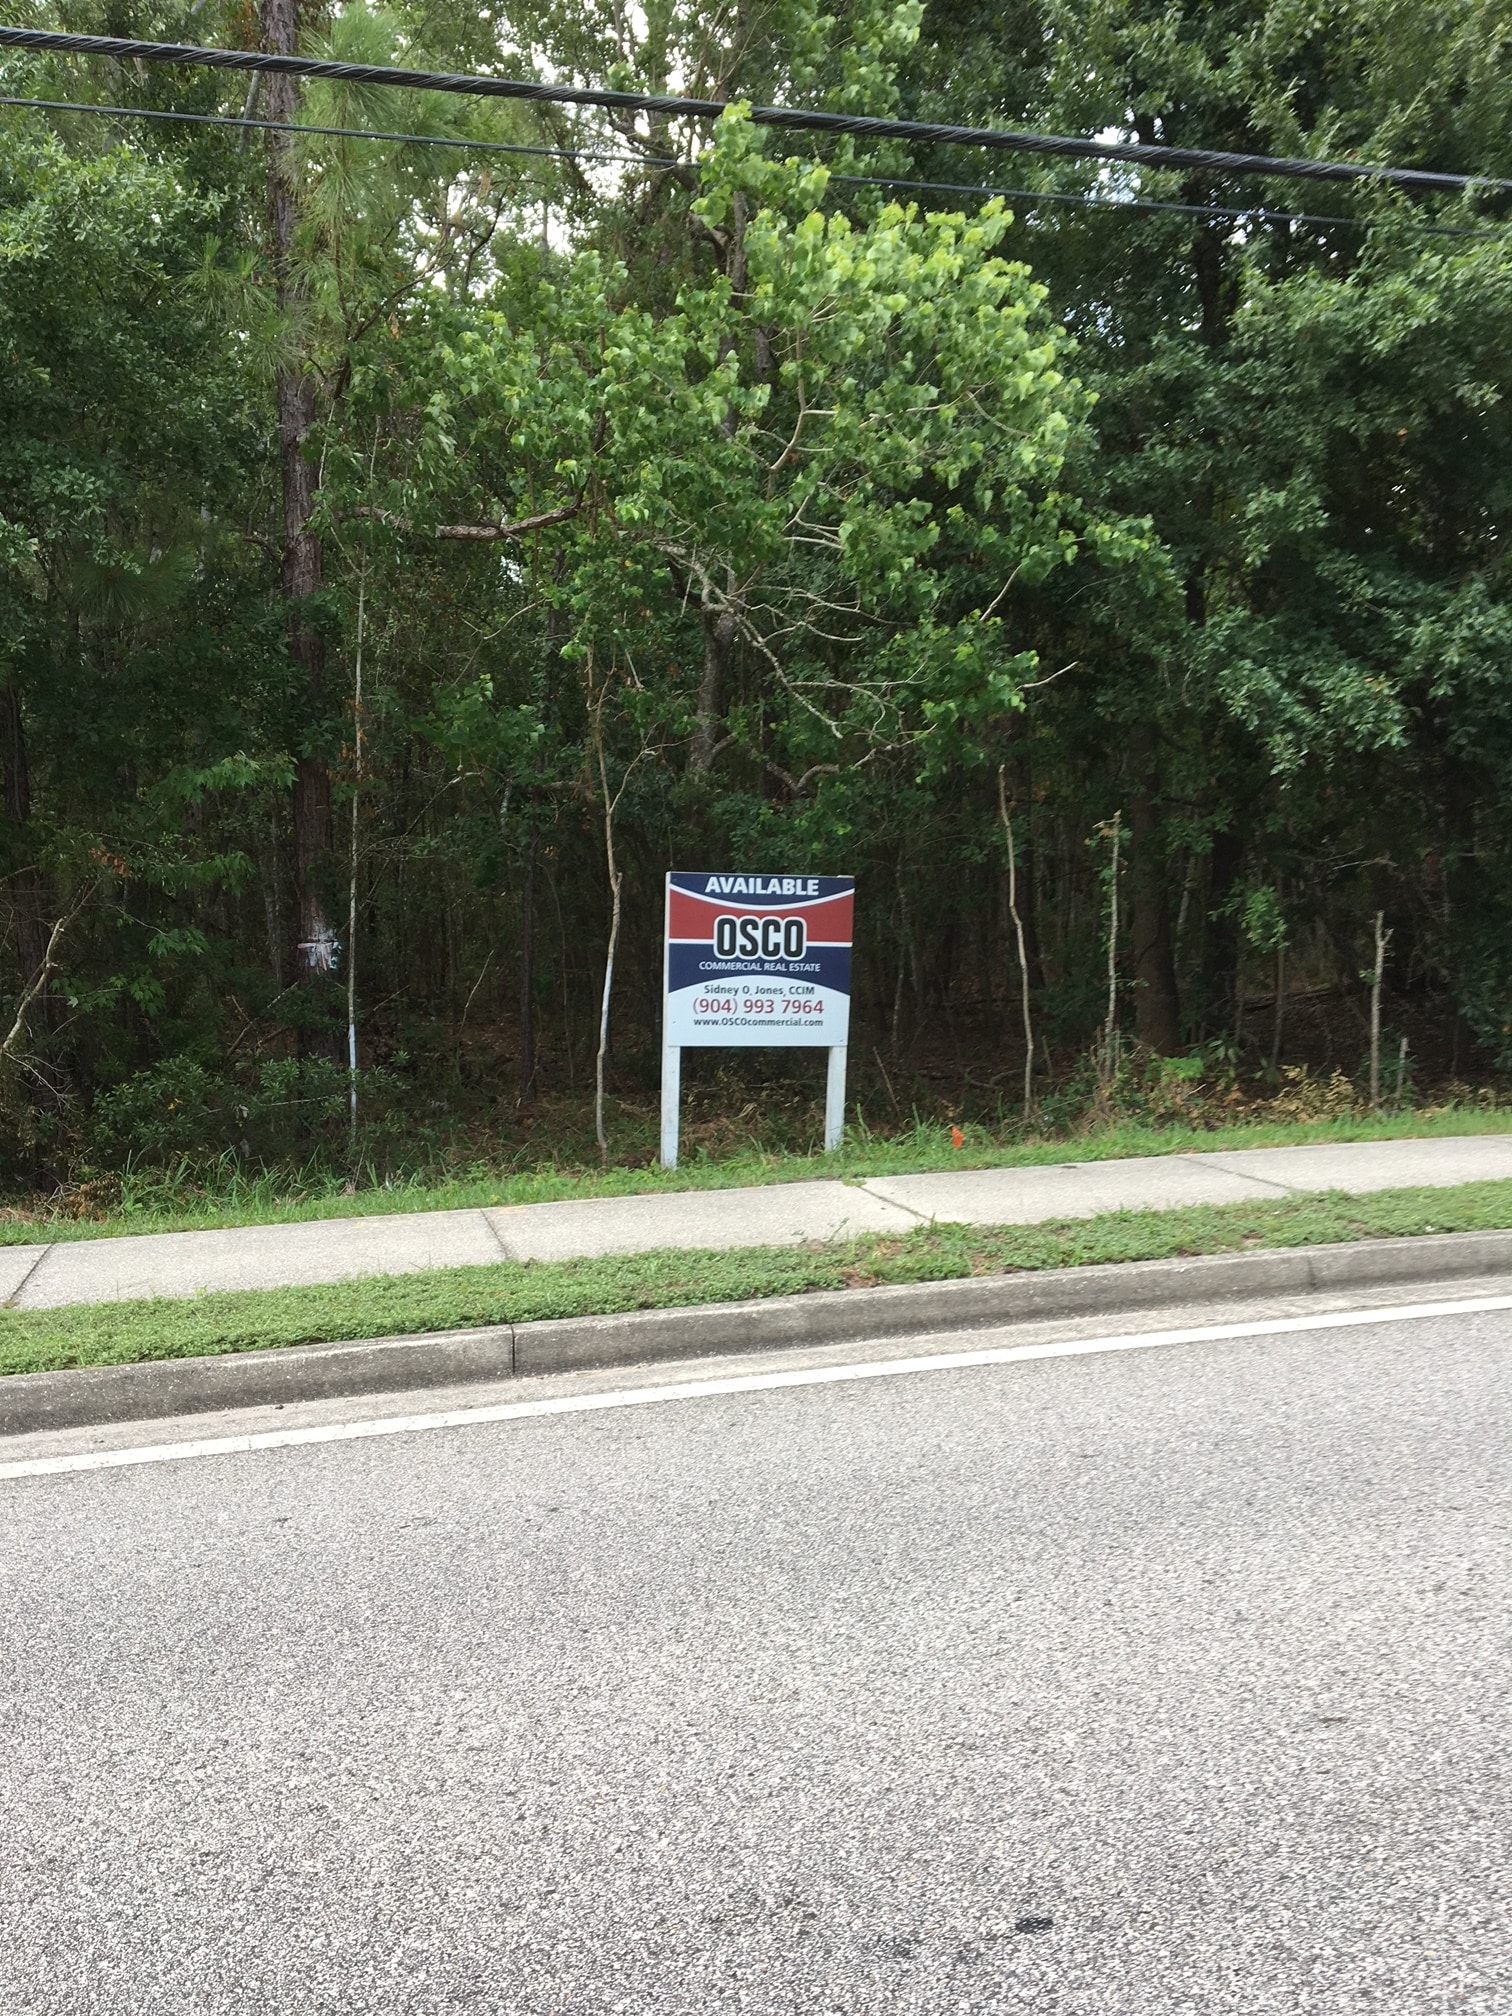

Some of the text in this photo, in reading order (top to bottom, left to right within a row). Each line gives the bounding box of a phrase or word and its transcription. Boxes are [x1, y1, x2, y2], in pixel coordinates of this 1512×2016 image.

[705, 877, 819, 895] AVAILABLE
[716, 917, 804, 958] OSCO
[699, 961, 821, 972] COMMERCIAL REAL ESTATE
[704, 985, 739, 996] Sidney
[755, 986, 786, 997] Jones,
[789, 986, 815, 995] CCIM
[693, 998, 824, 1014] (904) 993 7964
[694, 1017, 823, 1027] www.OSCOcommercial.com
